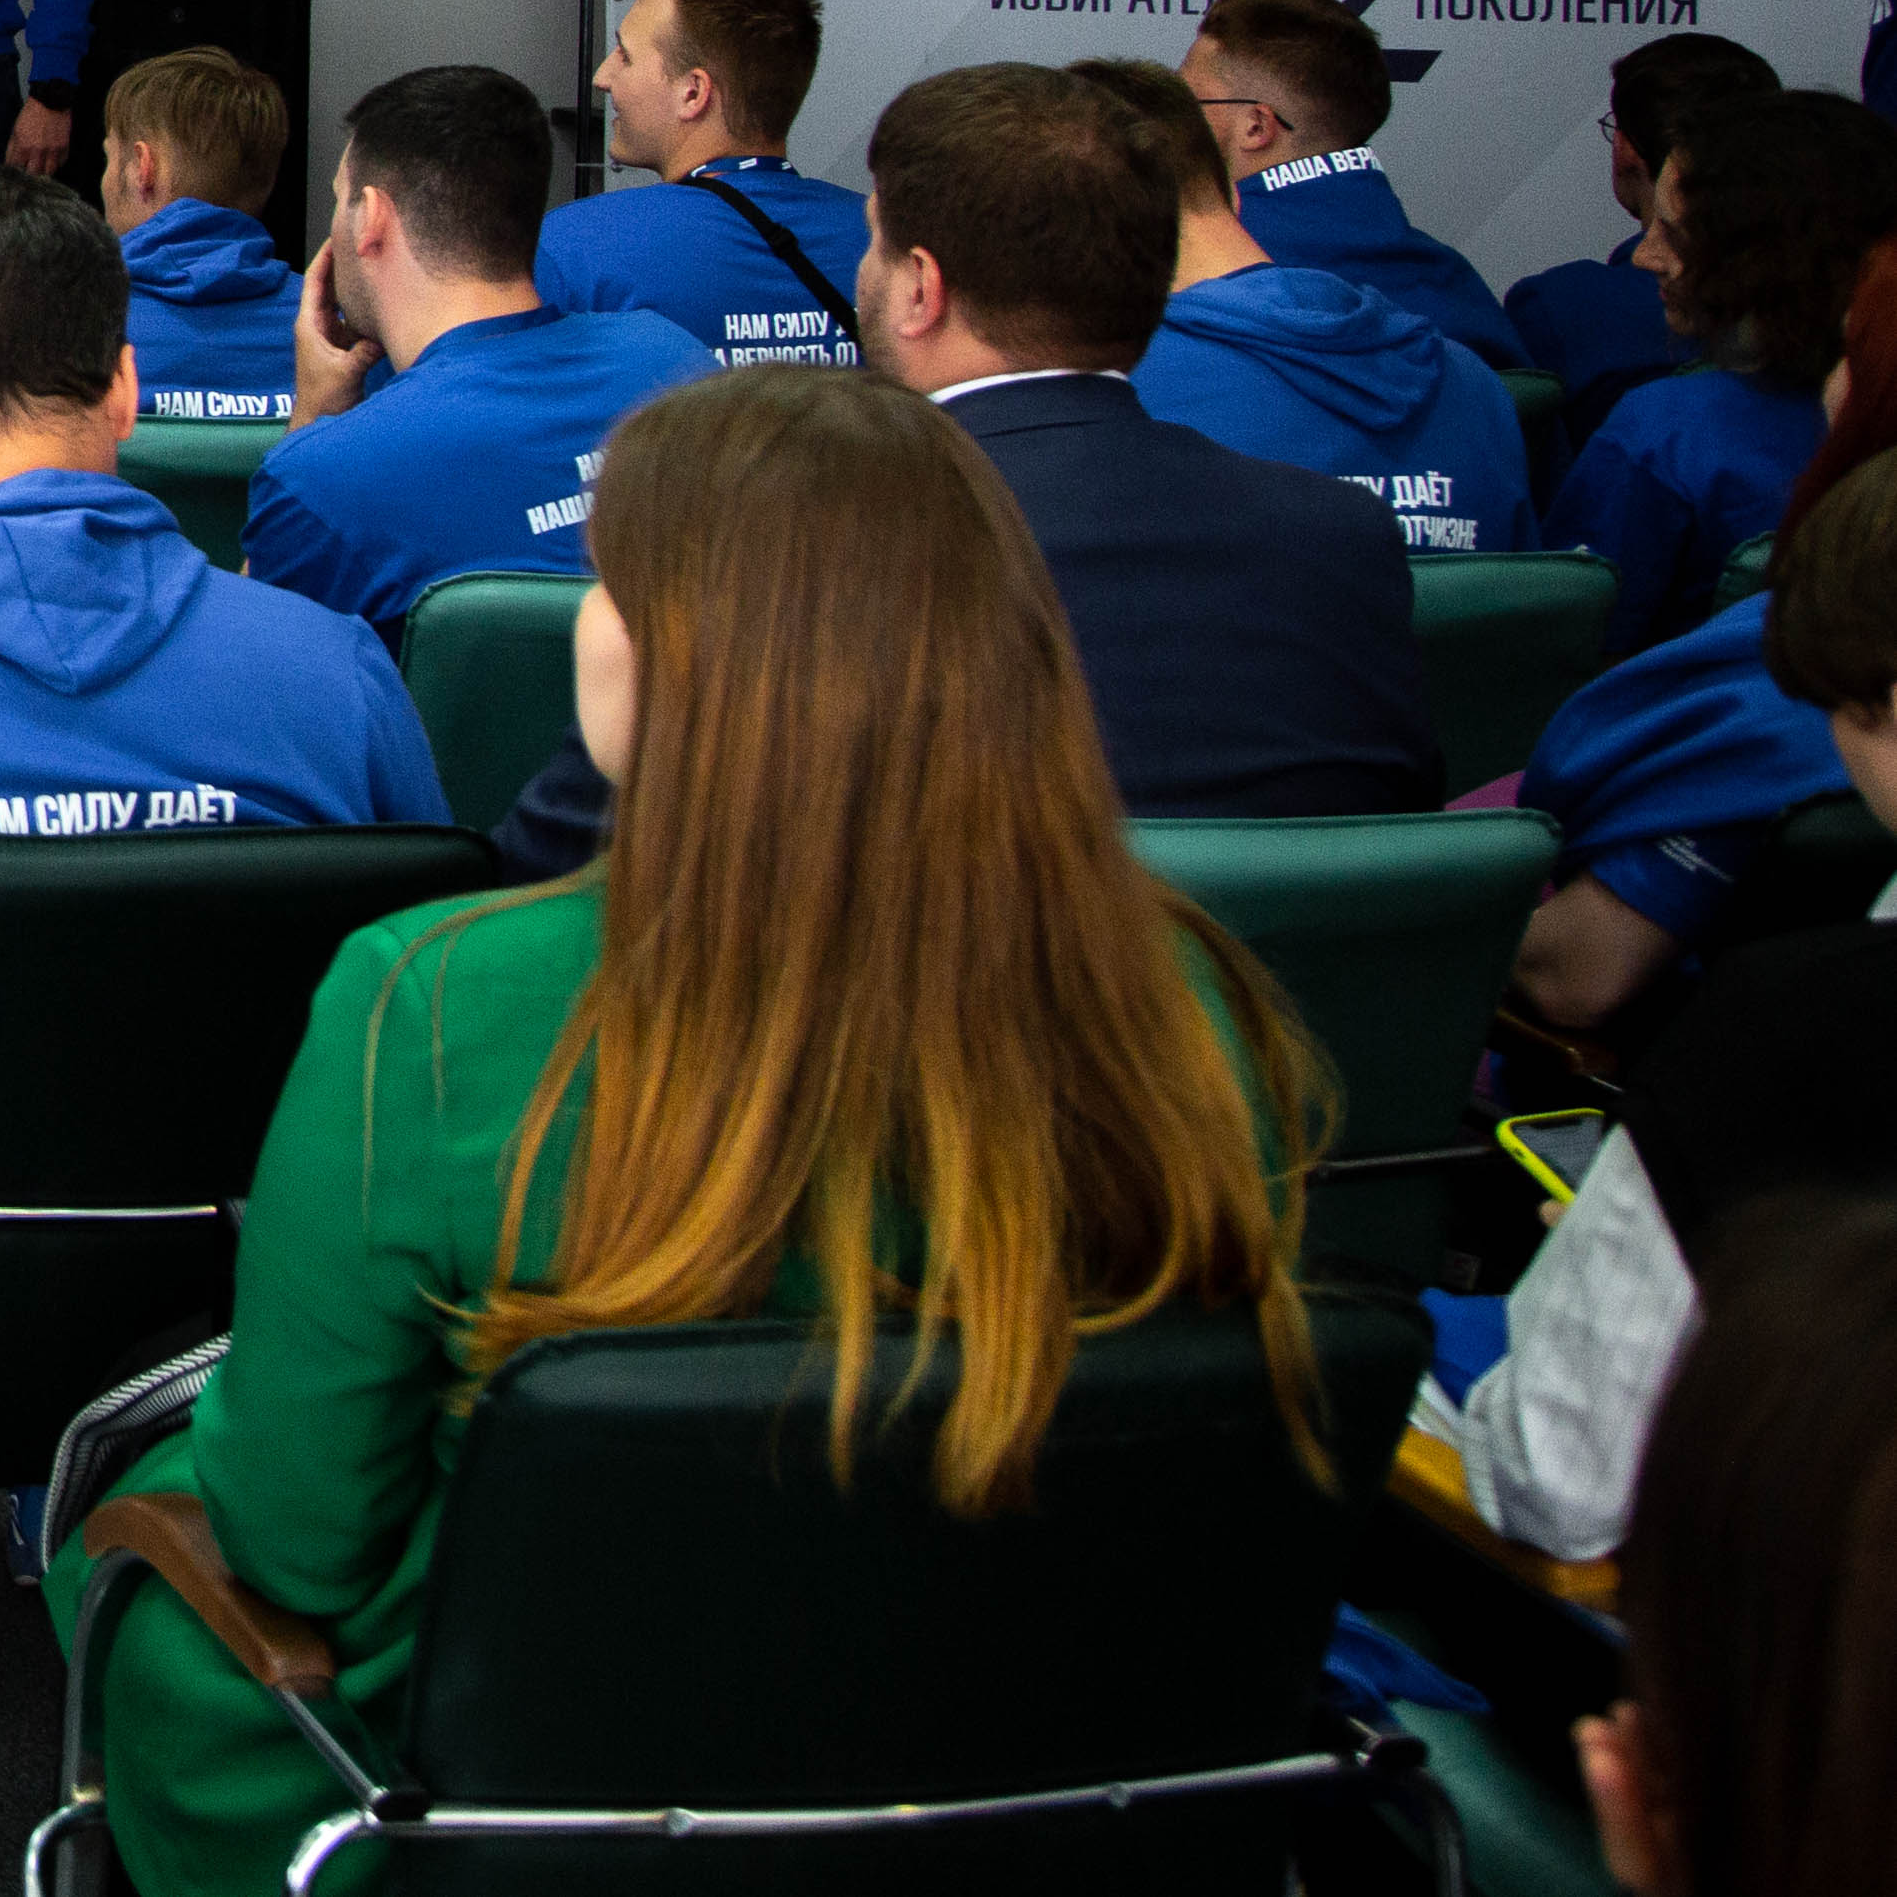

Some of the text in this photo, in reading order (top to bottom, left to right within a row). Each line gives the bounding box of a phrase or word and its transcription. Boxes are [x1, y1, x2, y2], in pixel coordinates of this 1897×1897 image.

[1261, 155, 1331, 191] НАША
[724, 314, 770, 340] НАМ
[773, 311, 829, 339] СИЛУ
[155, 391, 204, 418] НАМ
[207, 391, 268, 417] СИЛУ
[1391, 470, 1453, 509] ДАЁТ
[33, 792, 139, 836] СИЛУ
[144, 783, 238, 830] ДАЁТ
